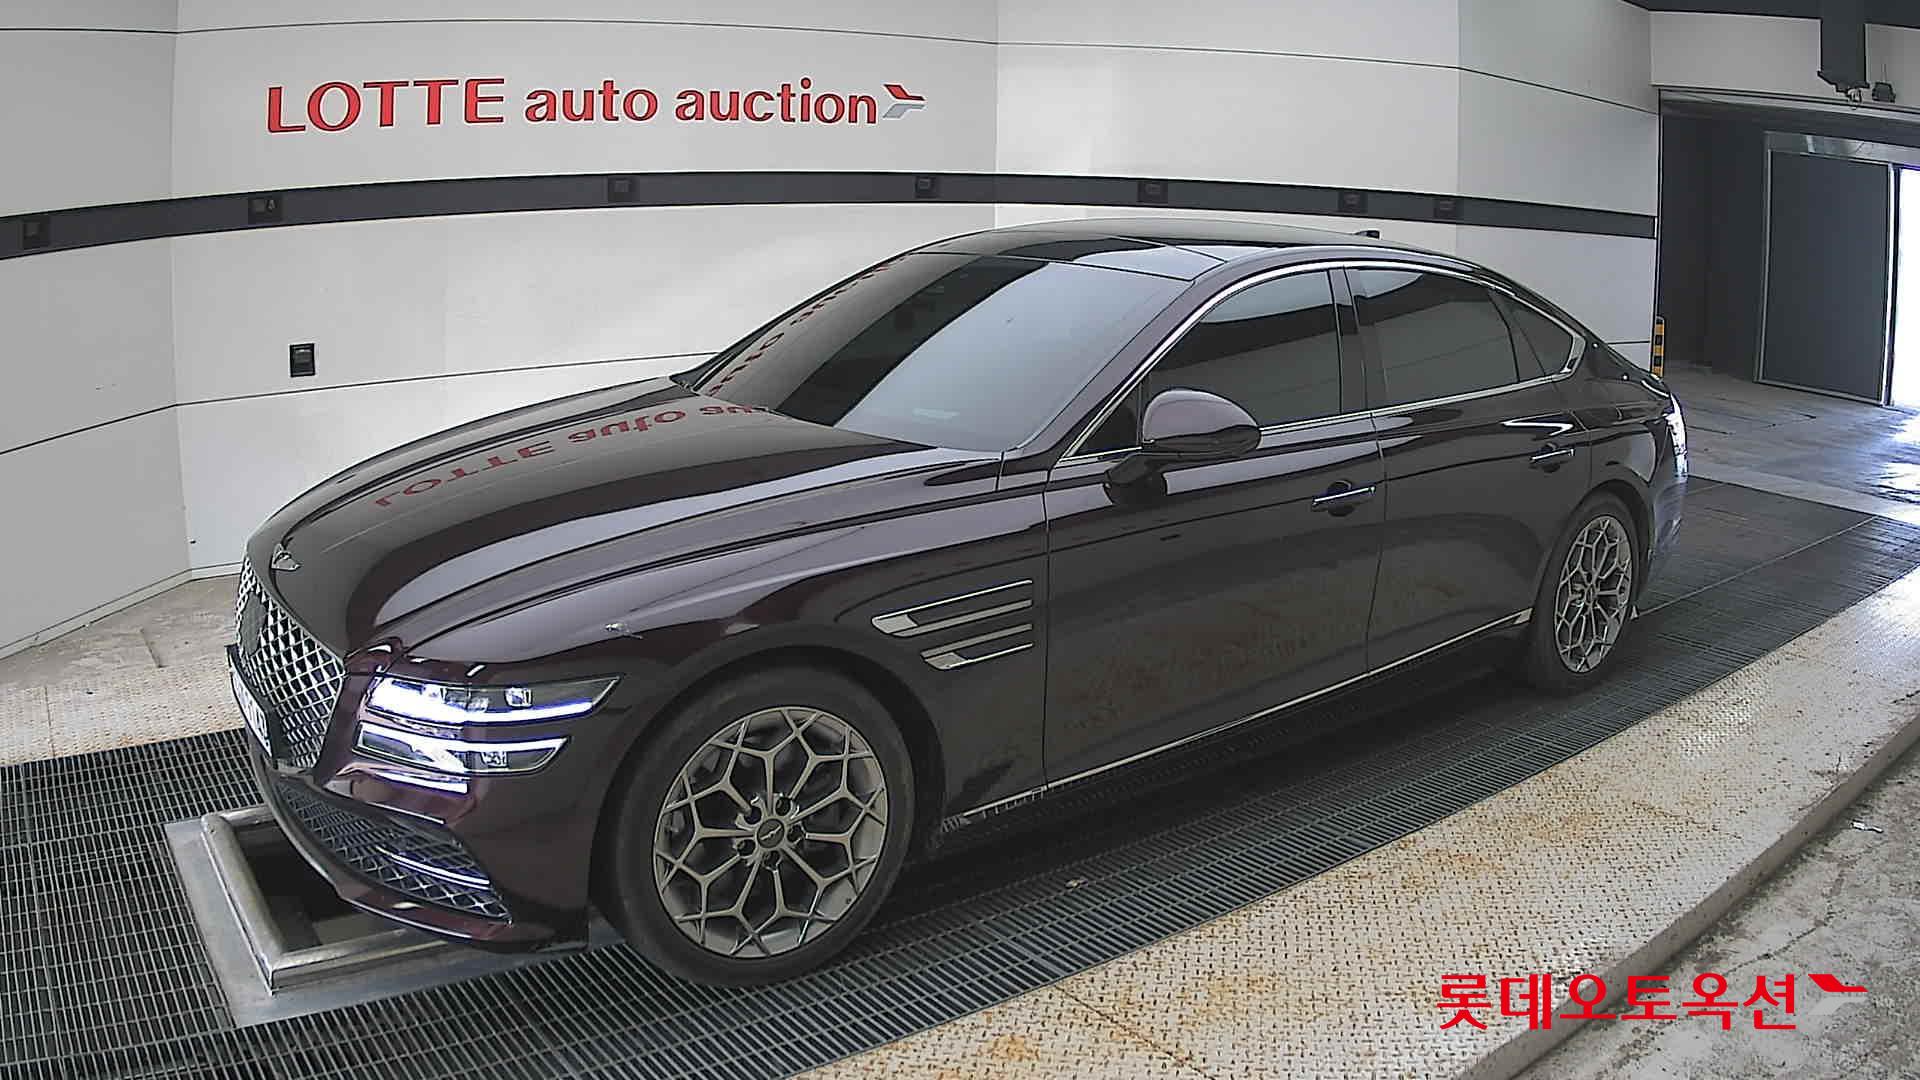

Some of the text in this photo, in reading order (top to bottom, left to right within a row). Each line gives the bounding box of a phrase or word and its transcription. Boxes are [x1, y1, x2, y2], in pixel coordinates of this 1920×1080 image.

[266, 77, 878, 133] LOTTE auto auction
